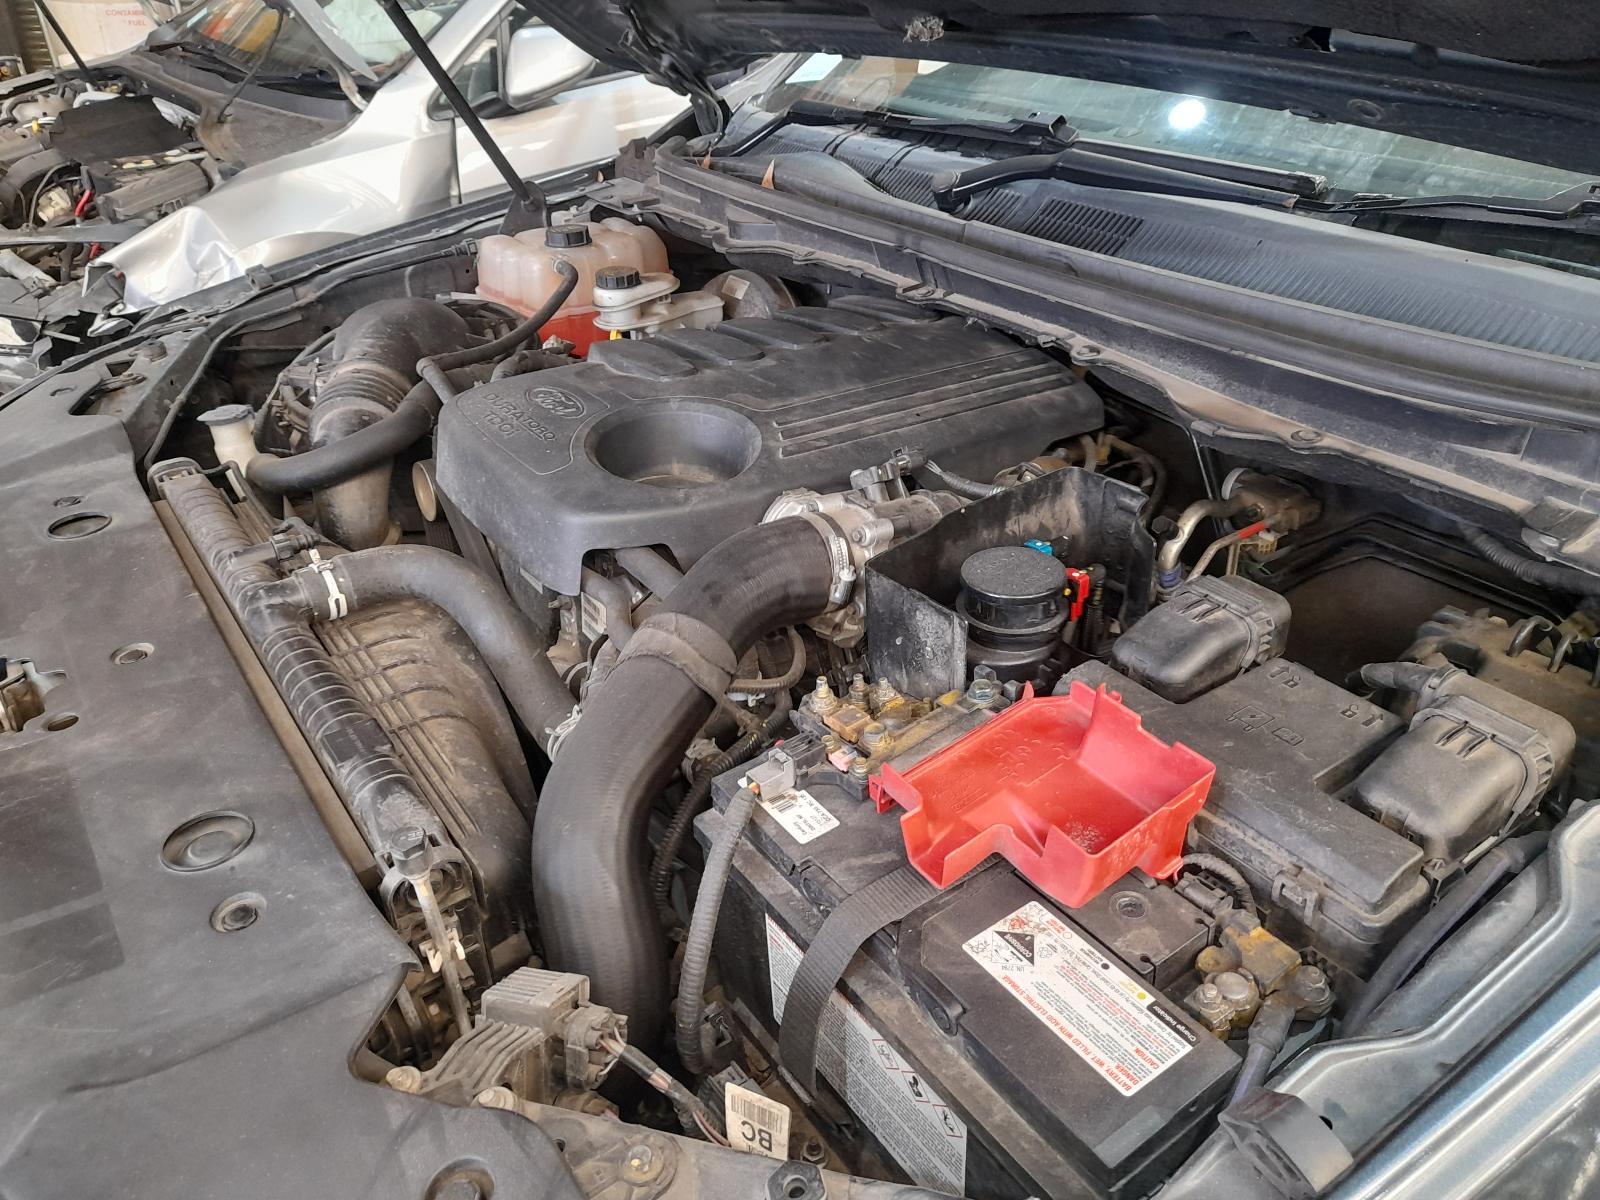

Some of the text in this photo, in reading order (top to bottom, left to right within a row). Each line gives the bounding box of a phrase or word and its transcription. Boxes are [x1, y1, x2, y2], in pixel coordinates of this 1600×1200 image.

[531, 388, 582, 417] Ford
[1003, 933, 1032, 958] CORROSIVE
[1001, 974, 1025, 995] STORAGE
[1022, 993, 1048, 1015] ELECTRIC
[1045, 1013, 1061, 1027] ACID
[1151, 1004, 1177, 1026] Indicator
[1057, 1025, 1074, 1039] WITH
[1174, 1022, 1197, 1042] Charge
[1071, 1037, 1092, 1055] FILLED
[741, 1120, 772, 1152] BC
